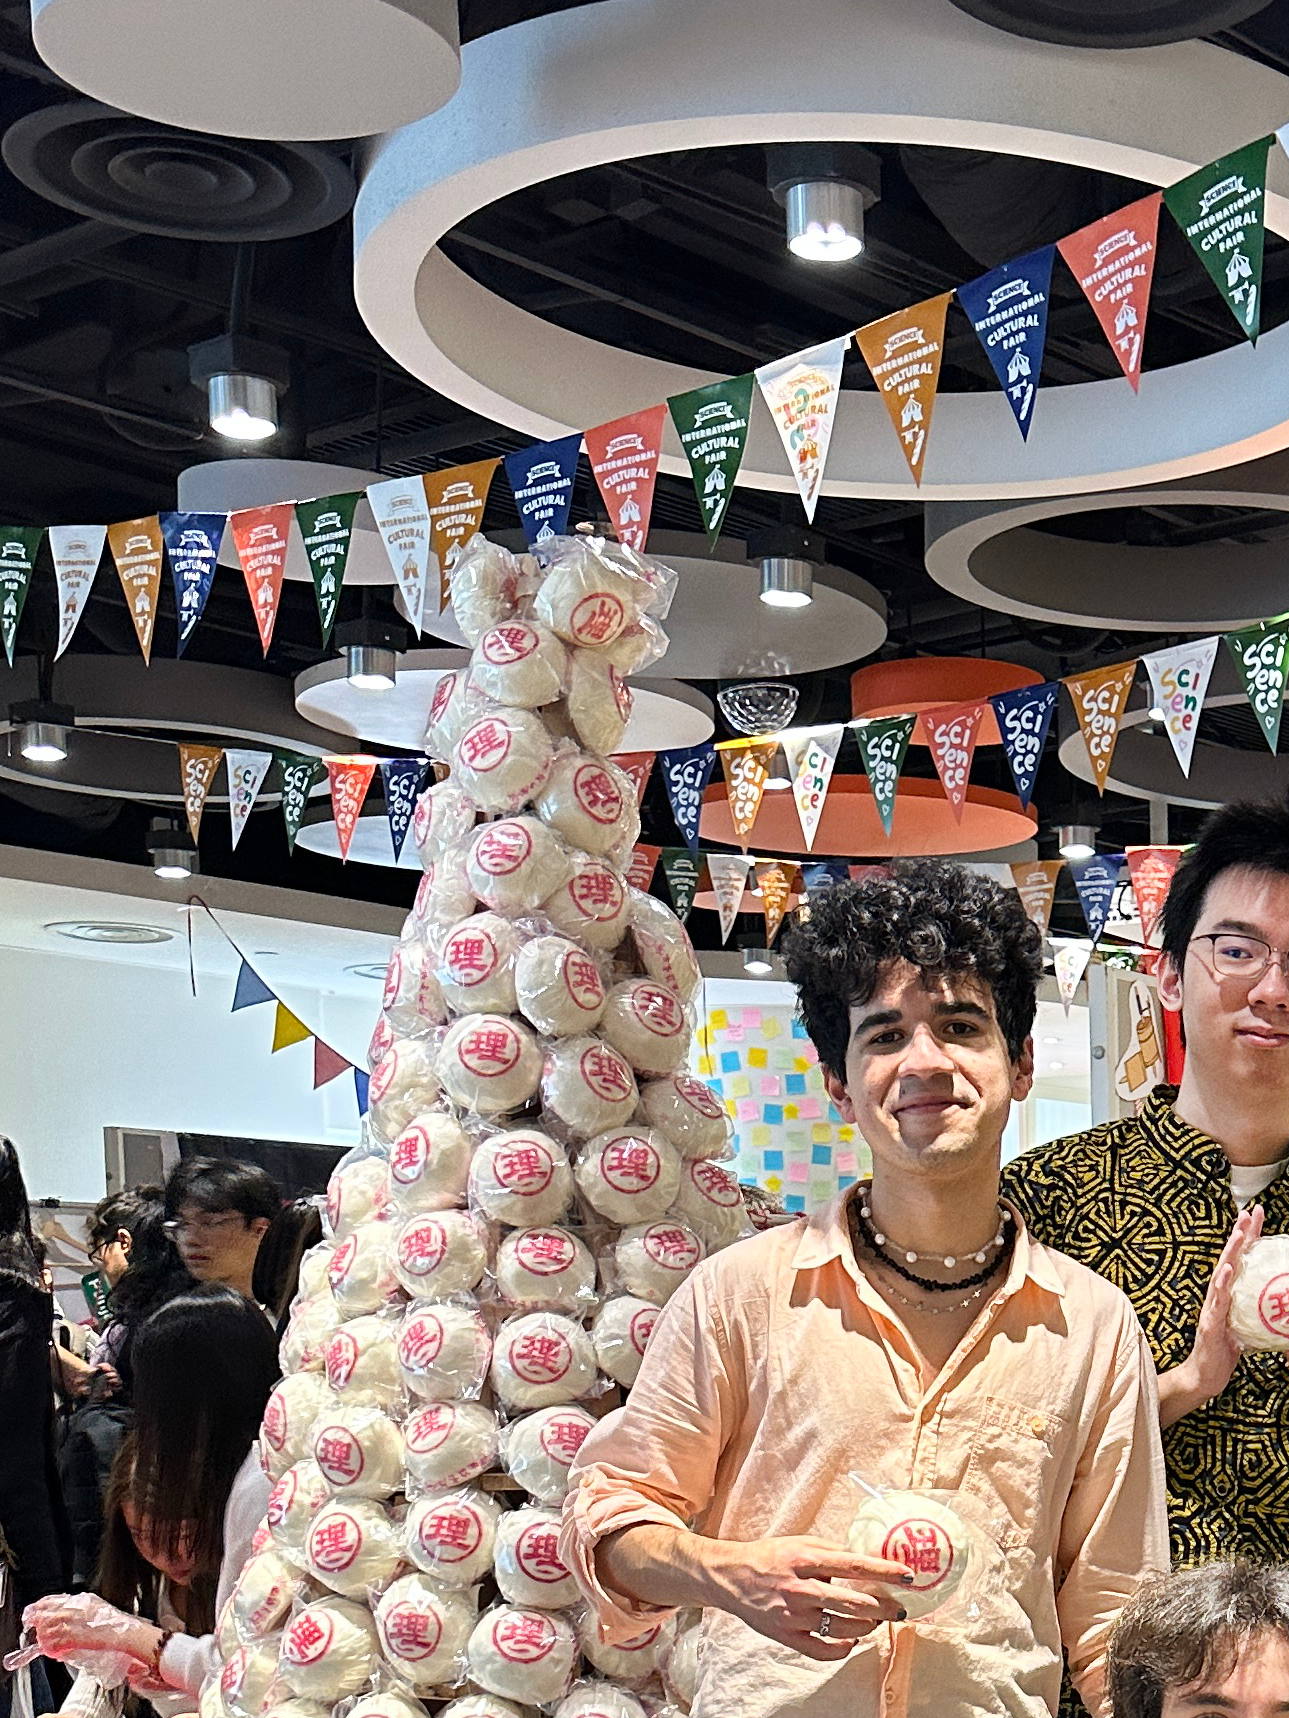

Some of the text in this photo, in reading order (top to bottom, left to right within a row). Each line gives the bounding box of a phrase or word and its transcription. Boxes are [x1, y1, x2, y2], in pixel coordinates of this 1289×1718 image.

[1205, 180, 1236, 202] SCIENCE
[1186, 187, 1262, 237] INTERNATIONAL
[1099, 234, 1128, 254] SCIENCE
[1201, 211, 1257, 251] CULTURAL
[1219, 232, 1245, 253] FAIR
[1082, 241, 1152, 288] INTERNATIONAL
[993, 283, 1023, 300] SCIENCE
[1094, 264, 1147, 302] CULTURAL
[1110, 284, 1134, 303] FAIR
[975, 293, 1046, 331] INTERNATIONAL
[889, 331, 918, 346] SCIENCE
[986, 314, 1040, 346] CULTURAL
[1002, 334, 1026, 350] FAIR
[872, 342, 939, 376] INTERNATIONAL
[883, 362, 933, 391] CULTURAL
[898, 379, 920, 395] FAIR
[682, 419, 746, 443] INTERNATIONAL
[594, 450, 656, 473] INTERNATIONAL
[692, 437, 739, 459] CULTURAL
[705, 451, 726, 464] FAIR
[515, 478, 571, 499] INTERNATIONAL
[603, 468, 650, 489] CULTURAL
[616, 482, 637, 494] FAIR
[522, 495, 565, 515] CULTURAL
[535, 507, 554, 520] FAIR
[387, 528, 425, 545] CULTURAL
[436, 515, 476, 532] CULTURAL
[447, 526, 465, 537] FAIR
[310, 545, 345, 560] CULTURAL
[399, 541, 415, 550] FAIR
[246, 556, 281, 572] CULTURAL
[320, 556, 336, 567] FAIR
[464, 723, 505, 762] 理
[578, 872, 617, 907] 理
[449, 938, 487, 977] 理
[572, 960, 601, 995] 理
[466, 1031, 511, 1065] 理
[591, 1052, 631, 1094] 理
[394, 1134, 420, 1169] 理
[607, 1146, 650, 1181] 理
[502, 1150, 547, 1188] 理
[650, 1230, 696, 1261] 理
[515, 1334, 561, 1375] 理
[413, 1407, 446, 1443] 理
[320, 1438, 355, 1476] 理
[315, 1521, 351, 1564] 理
[425, 1514, 471, 1550] 理
[892, 1526, 941, 1573] 理
[389, 1612, 432, 1651] 理
[500, 1616, 545, 1653] 理
